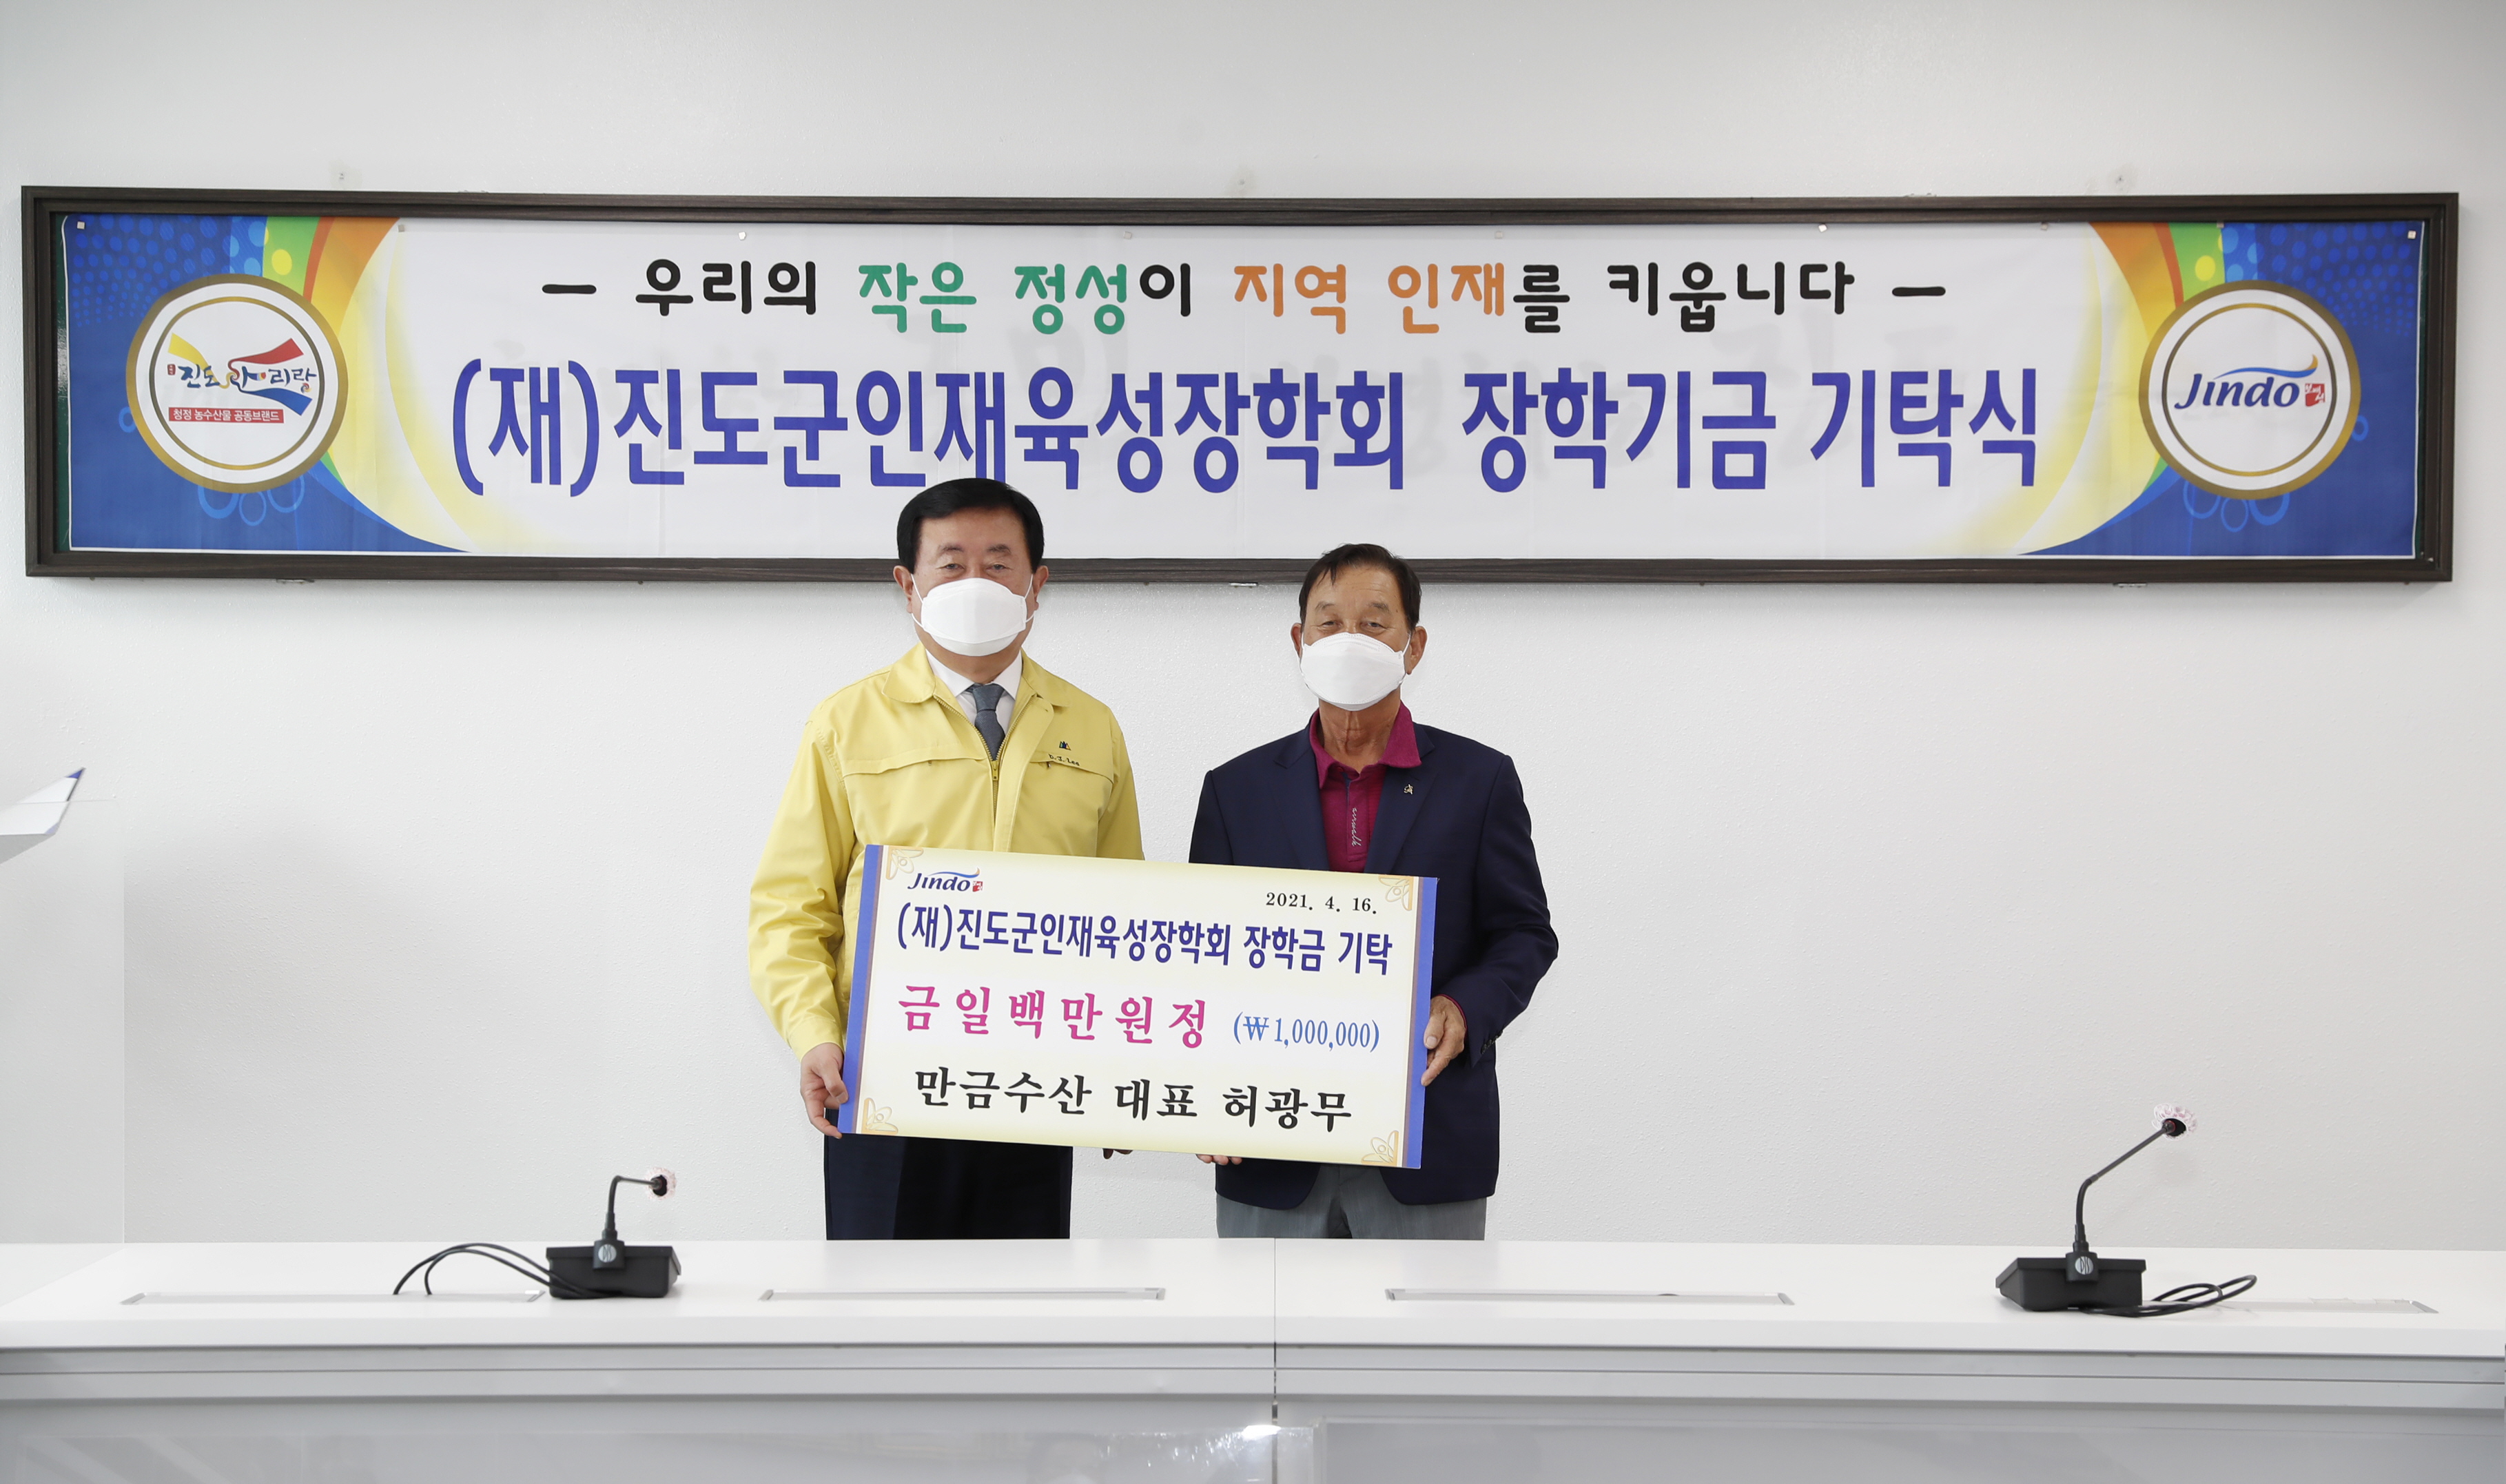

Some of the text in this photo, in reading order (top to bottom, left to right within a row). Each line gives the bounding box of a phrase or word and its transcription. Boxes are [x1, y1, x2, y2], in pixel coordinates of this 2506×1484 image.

[635, 258, 816, 317] 우리의
[858, 261, 977, 333] 작은
[1014, 262, 1191, 335] 정성이
[1234, 262, 1346, 335] 지역
[1388, 262, 1570, 334] 인재를
[1607, 260, 1856, 333] 키웁니다
[173, 409, 280, 422] 청정 농수산물 공동브랜드
[2174, 373, 2300, 410] Jindo
[453, 358, 2037, 496] (재)진도군인재육성장학회 장학기금 기탁식
[907, 872, 971, 892] Jindo
[1266, 892, 1377, 915] 2021. 4. 16.
[898, 902, 1393, 976] (재)진도군인재육성장학회 장학금 기탁
[915, 1066, 1353, 1133] 만금수산 대표 허광무
